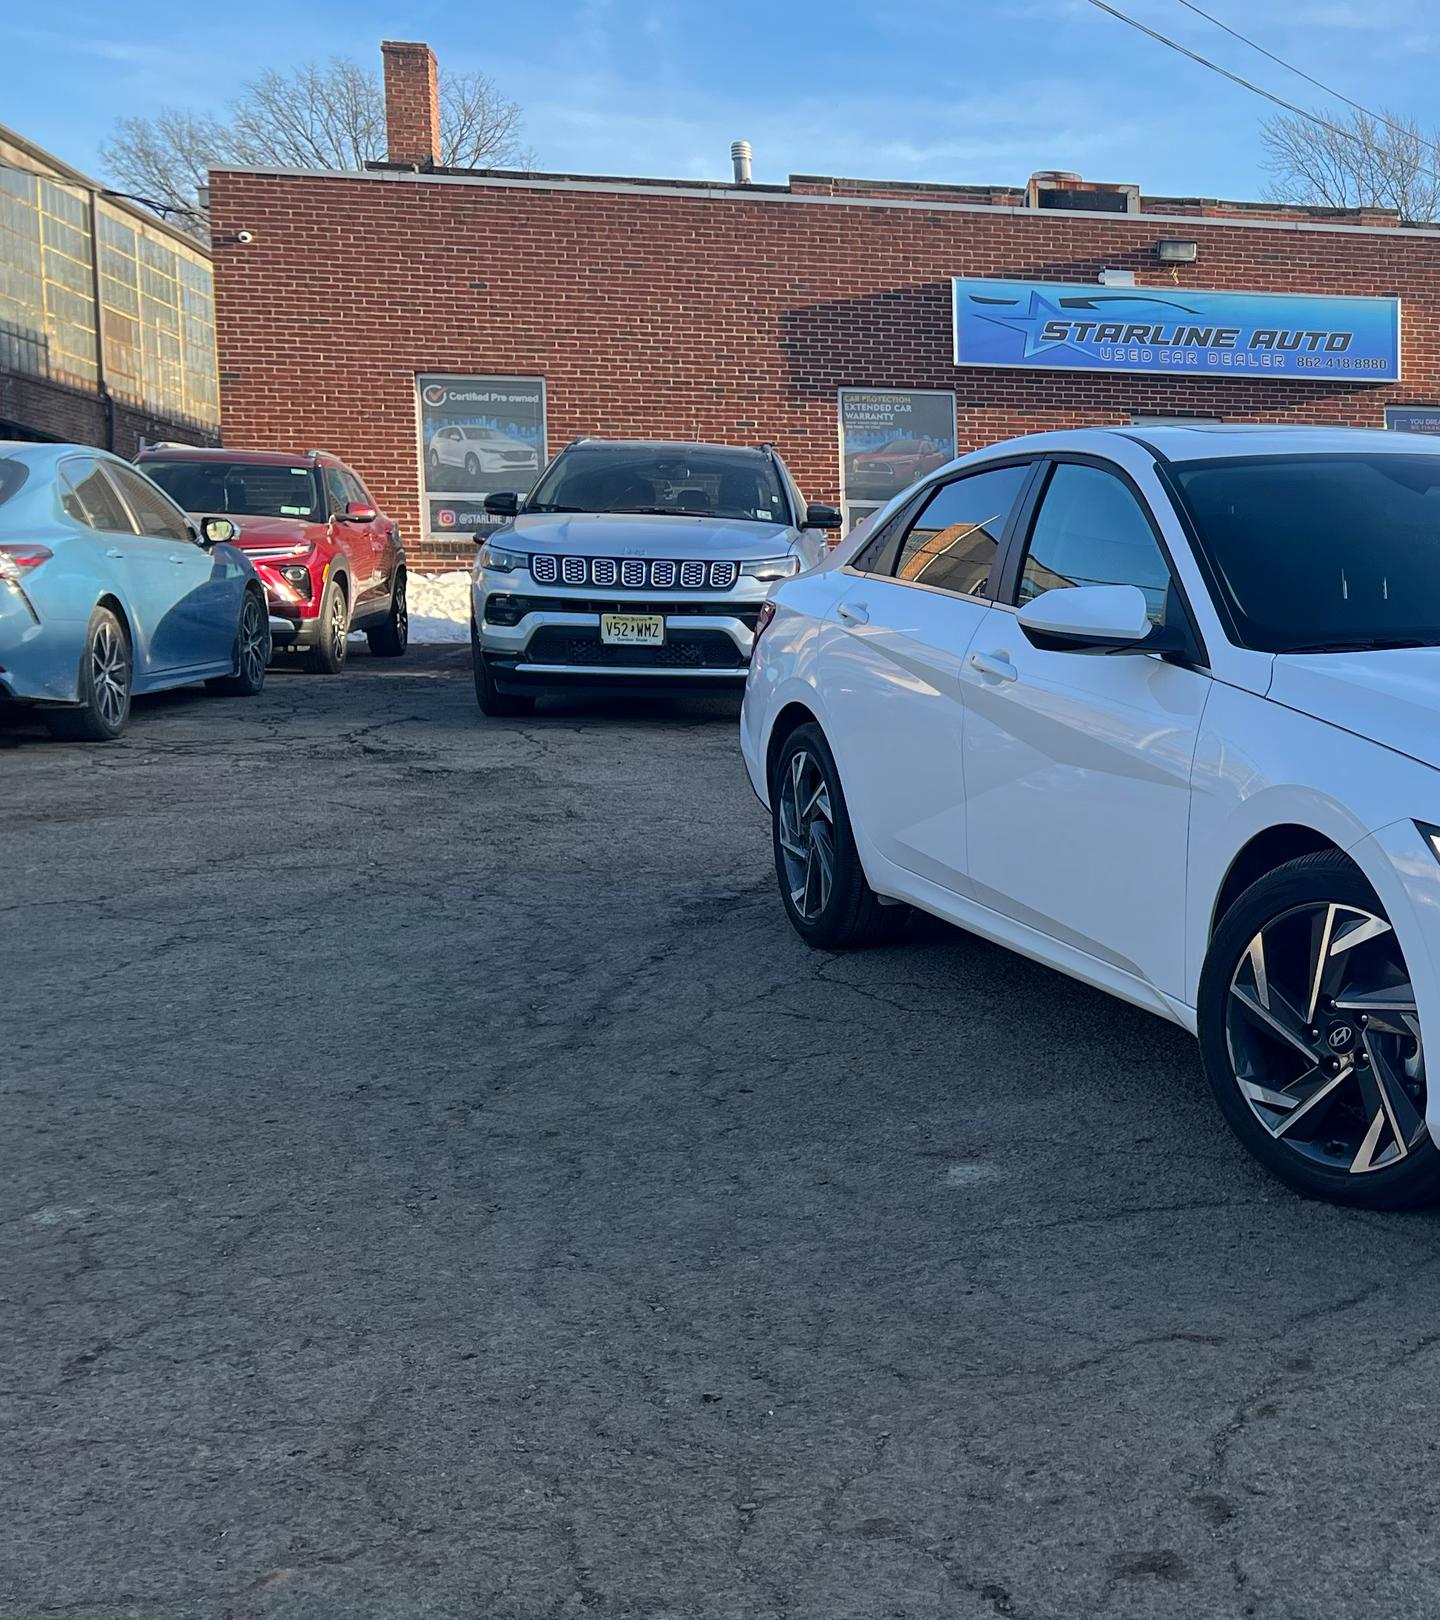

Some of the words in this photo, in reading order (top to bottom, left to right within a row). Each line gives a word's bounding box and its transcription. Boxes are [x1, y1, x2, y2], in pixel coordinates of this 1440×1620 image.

[1040, 320, 1241, 348] STARLINE
[1248, 329, 1353, 352] AUTO
[1100, 347, 1152, 363] USED
[1159, 350, 1198, 364] CAR
[1207, 352, 1285, 367] DEALER
[449, 391, 489, 401] Certified
[490, 393, 507, 402] Pre
[508, 394, 539, 403] owned
[844, 403, 891, 411] EXTENDED
[894, 404, 912, 412] CAR
[845, 412, 895, 420] WARRANTY
